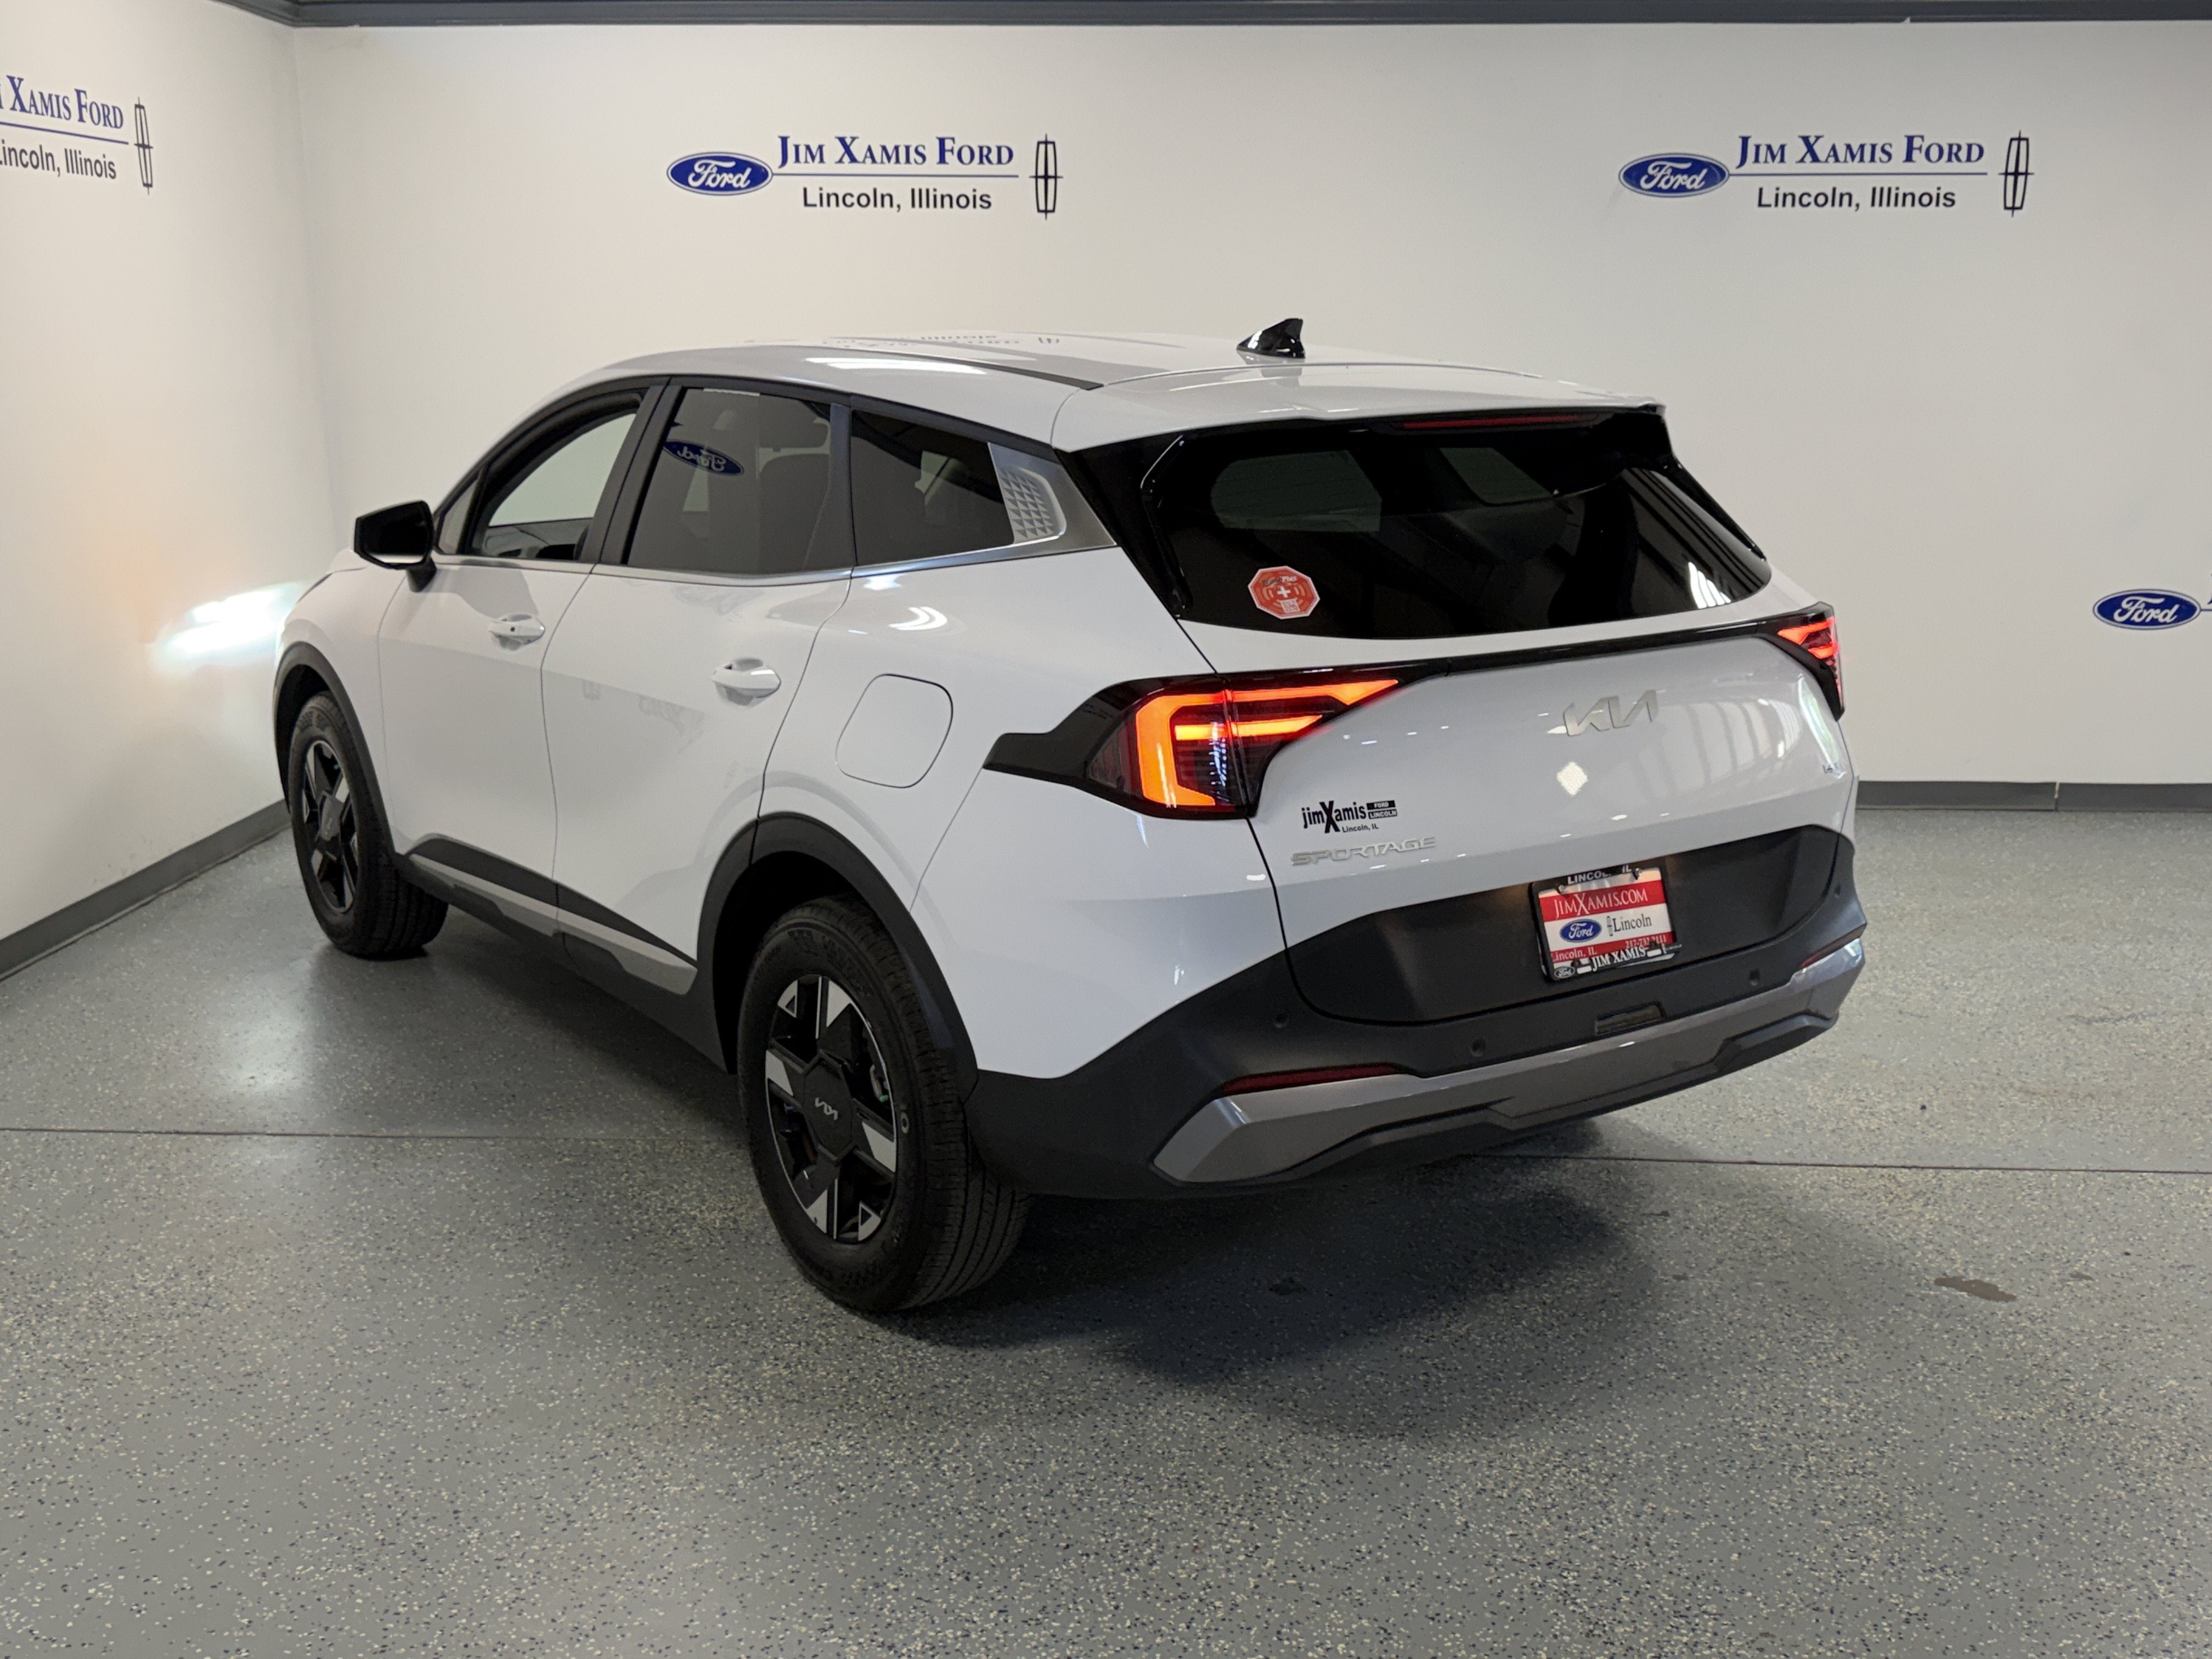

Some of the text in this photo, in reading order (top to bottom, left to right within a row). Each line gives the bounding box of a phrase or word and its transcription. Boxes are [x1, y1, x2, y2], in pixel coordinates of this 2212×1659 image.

[74, 88, 123, 129] FORD
[0, 139, 116, 179] incoln, Illinois
[688, 160, 751, 188] Ford
[1640, 161, 1707, 190] Ford
[803, 187, 992, 213] Lincoln, Illinois
[1757, 187, 1956, 212] Lincoln, Illinois
[2113, 596, 2180, 623] Ford
[1342, 825, 1370, 833] Lincoln,
[1290, 837, 1436, 866] SPORTAGE
[1622, 864, 1632, 873] IL
[1568, 923, 1594, 939] Ford
[1612, 913, 1652, 933] Lincoln
[1588, 946, 1598, 956] IL
[1591, 945, 1646, 972] JIM XAMIS
